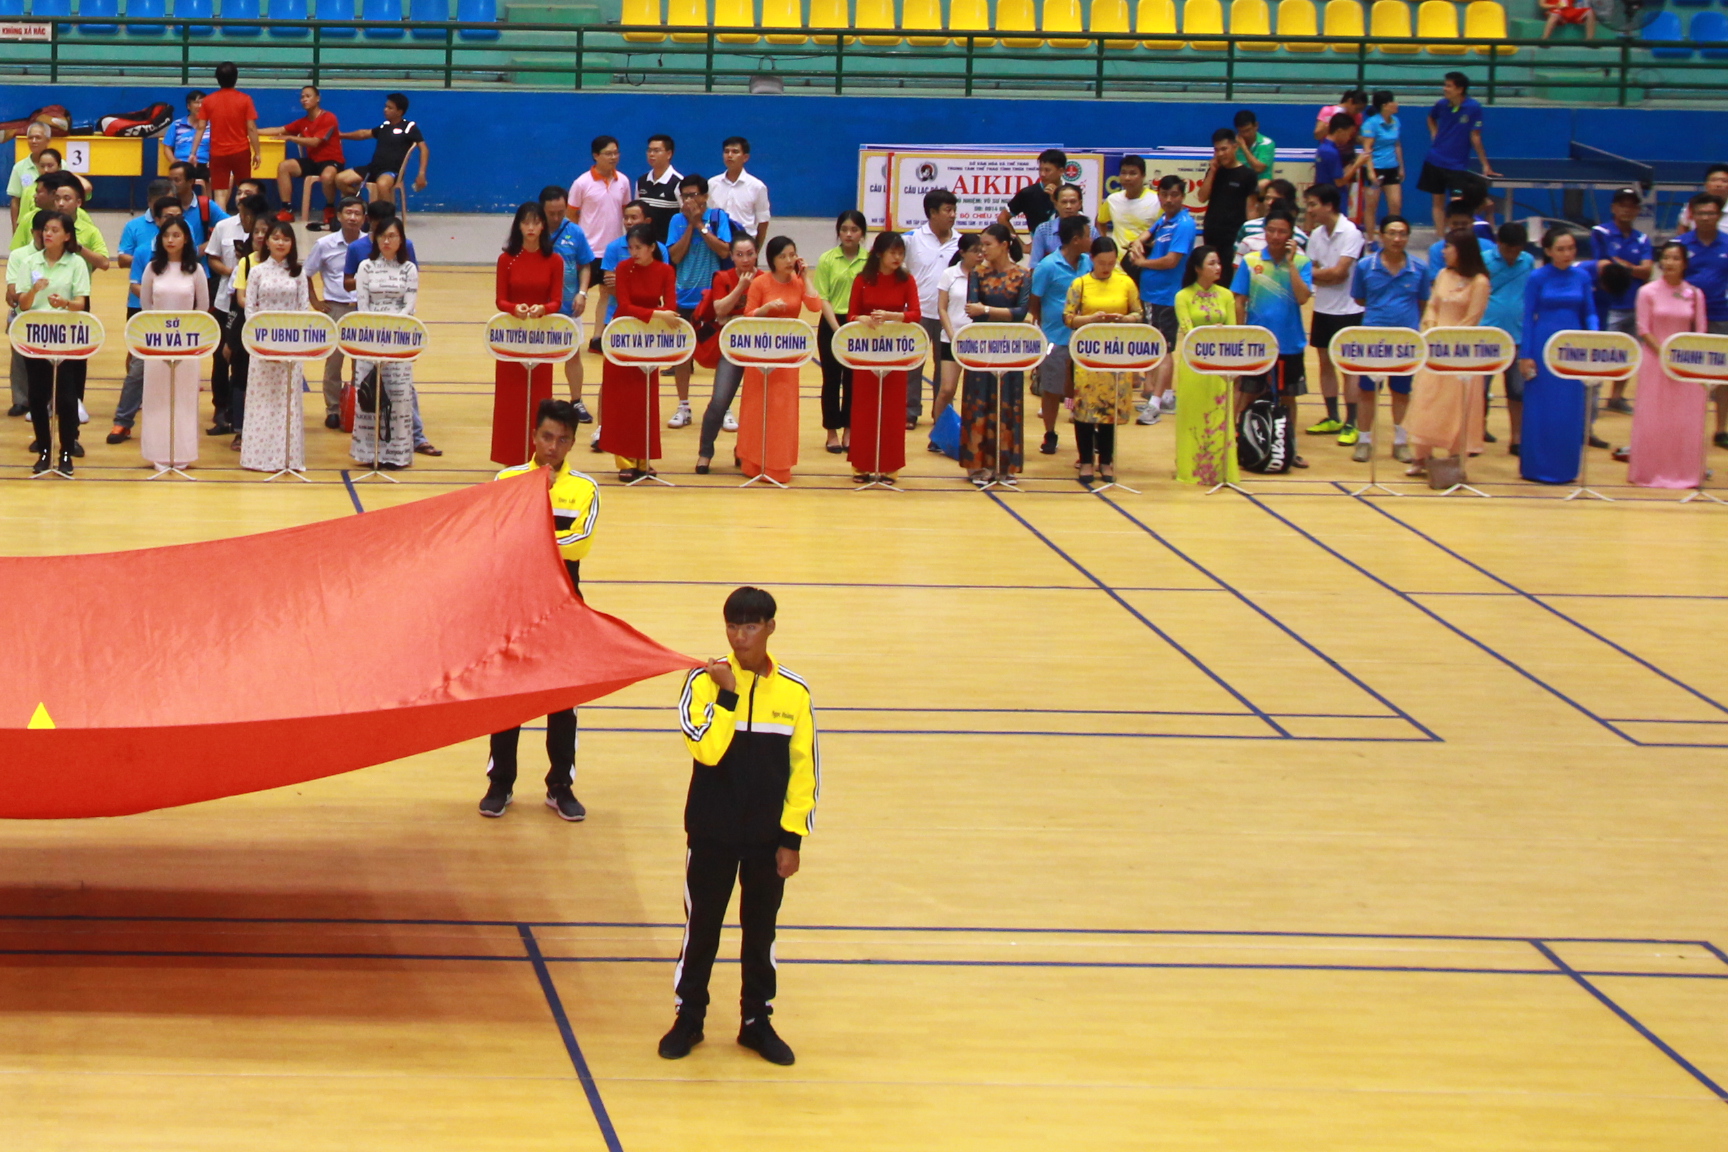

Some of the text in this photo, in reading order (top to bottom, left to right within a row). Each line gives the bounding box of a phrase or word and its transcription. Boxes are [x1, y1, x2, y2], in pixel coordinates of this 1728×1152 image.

[72, 150, 82, 165] 3
[952, 175, 1042, 194] AIKID
[26, 320, 89, 348] TRỌNG TÀI
[145, 331, 200, 346] VH VÀ TT
[255, 324, 326, 342] VP UBND TỈNH
[341, 326, 421, 346] BAN DÂN VẬN TỈNH ỦY
[490, 327, 573, 345] BAN TUYÊN GIÁO TỈNH ỦY
[611, 331, 686, 348] UBKT VÀ VP TỈNH ỦY
[730, 331, 806, 351] BAN NỘI CHÍNH
[848, 335, 915, 355] BAN DÂN TỘC
[1077, 337, 1159, 357] CỤC HẢI QUAN
[1195, 339, 1265, 359] CỤC THUẾ TTH
[1340, 341, 1364, 361] VIỆN
[1397, 341, 1416, 358] SÁT
